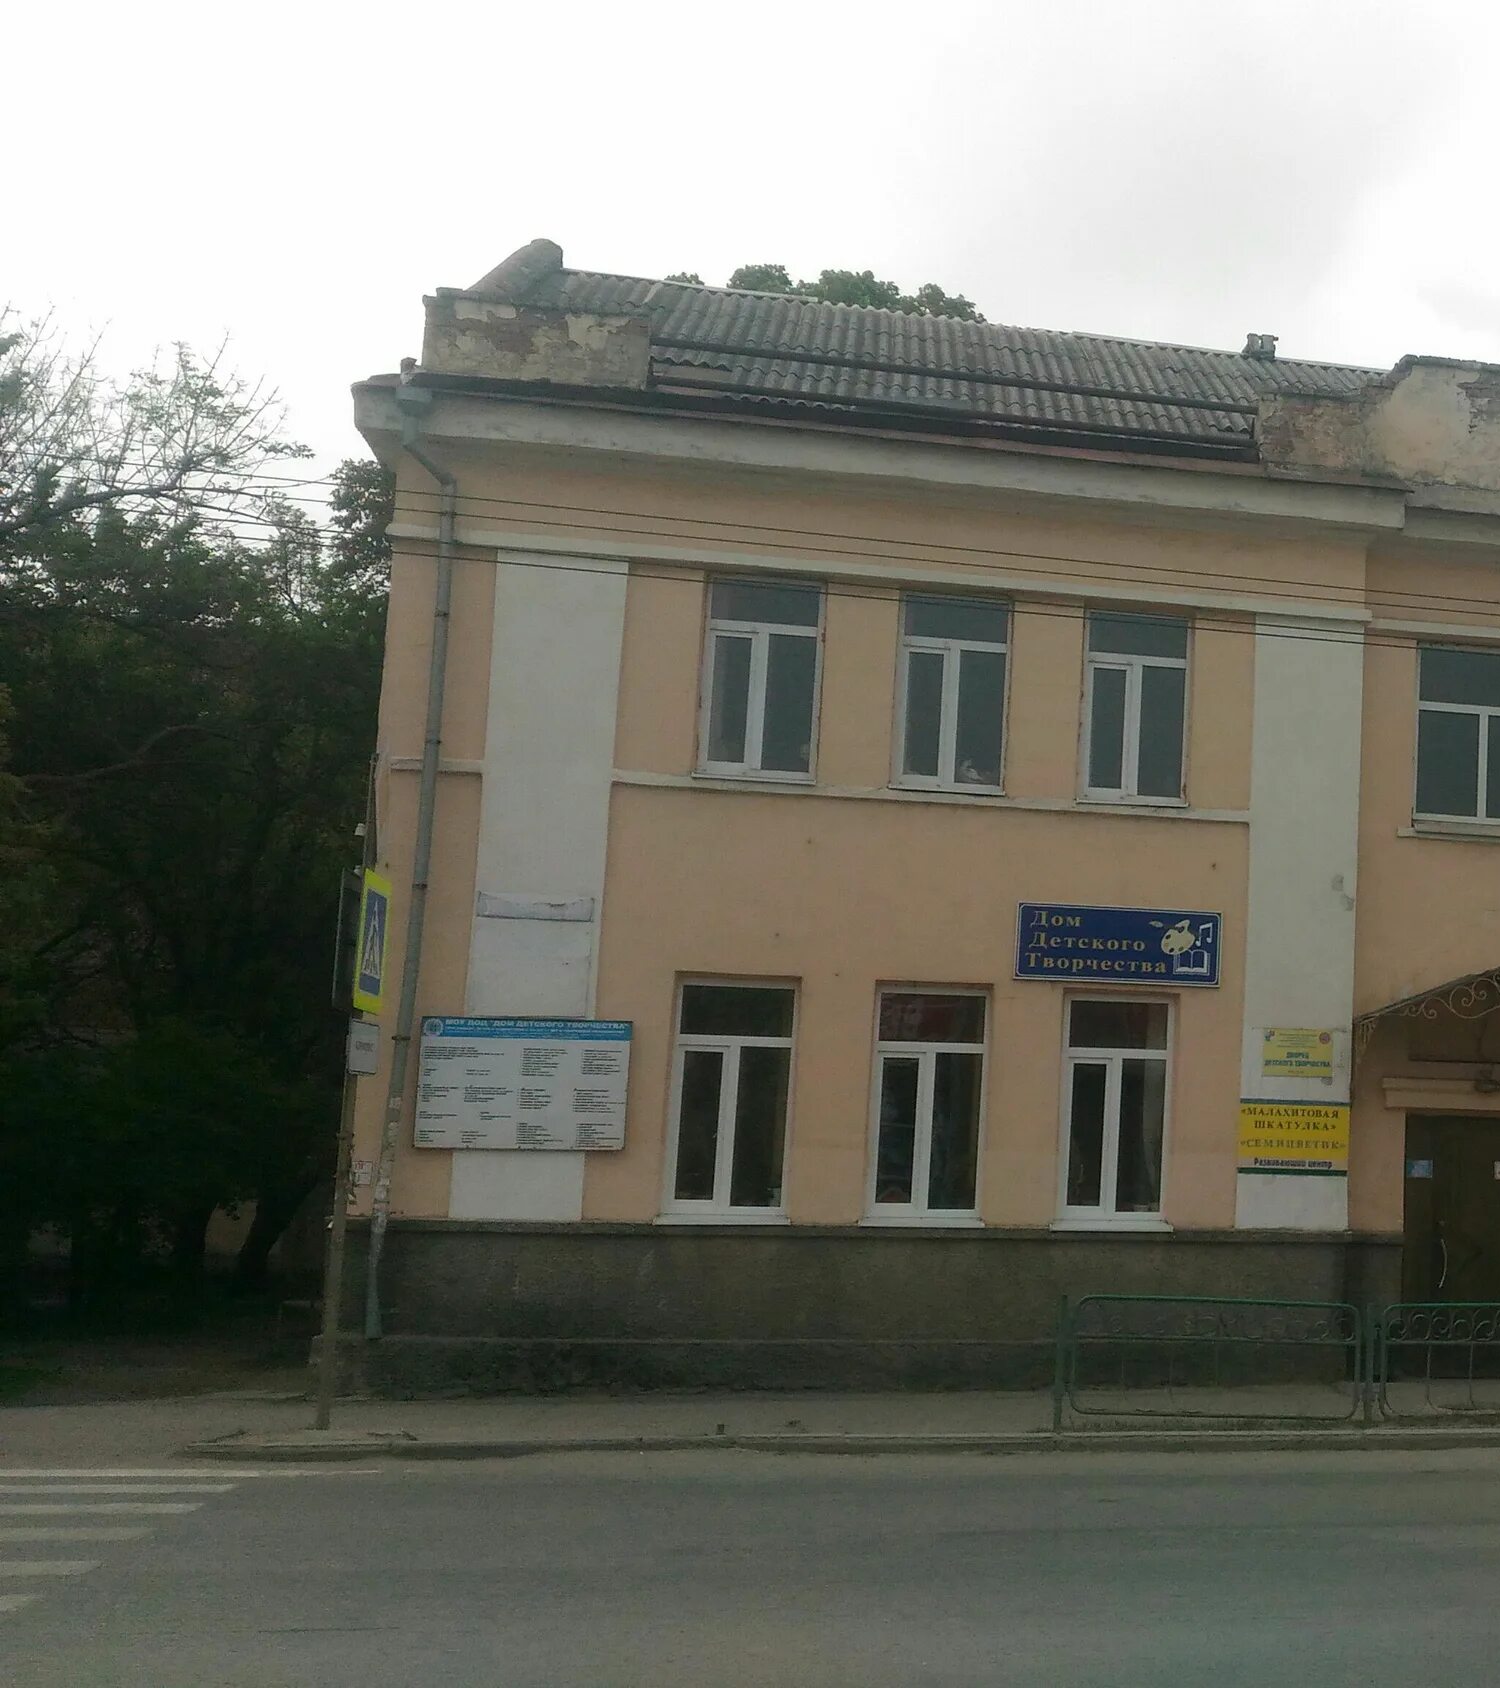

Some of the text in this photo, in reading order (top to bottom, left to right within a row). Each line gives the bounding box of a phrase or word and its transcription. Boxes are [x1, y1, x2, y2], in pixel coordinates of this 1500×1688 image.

[1030, 910, 1083, 928] Дом
[1028, 931, 1146, 952] Детского
[1025, 952, 1167, 973] Творчества
[516, 1020, 564, 1028] ДЕТСКОГО
